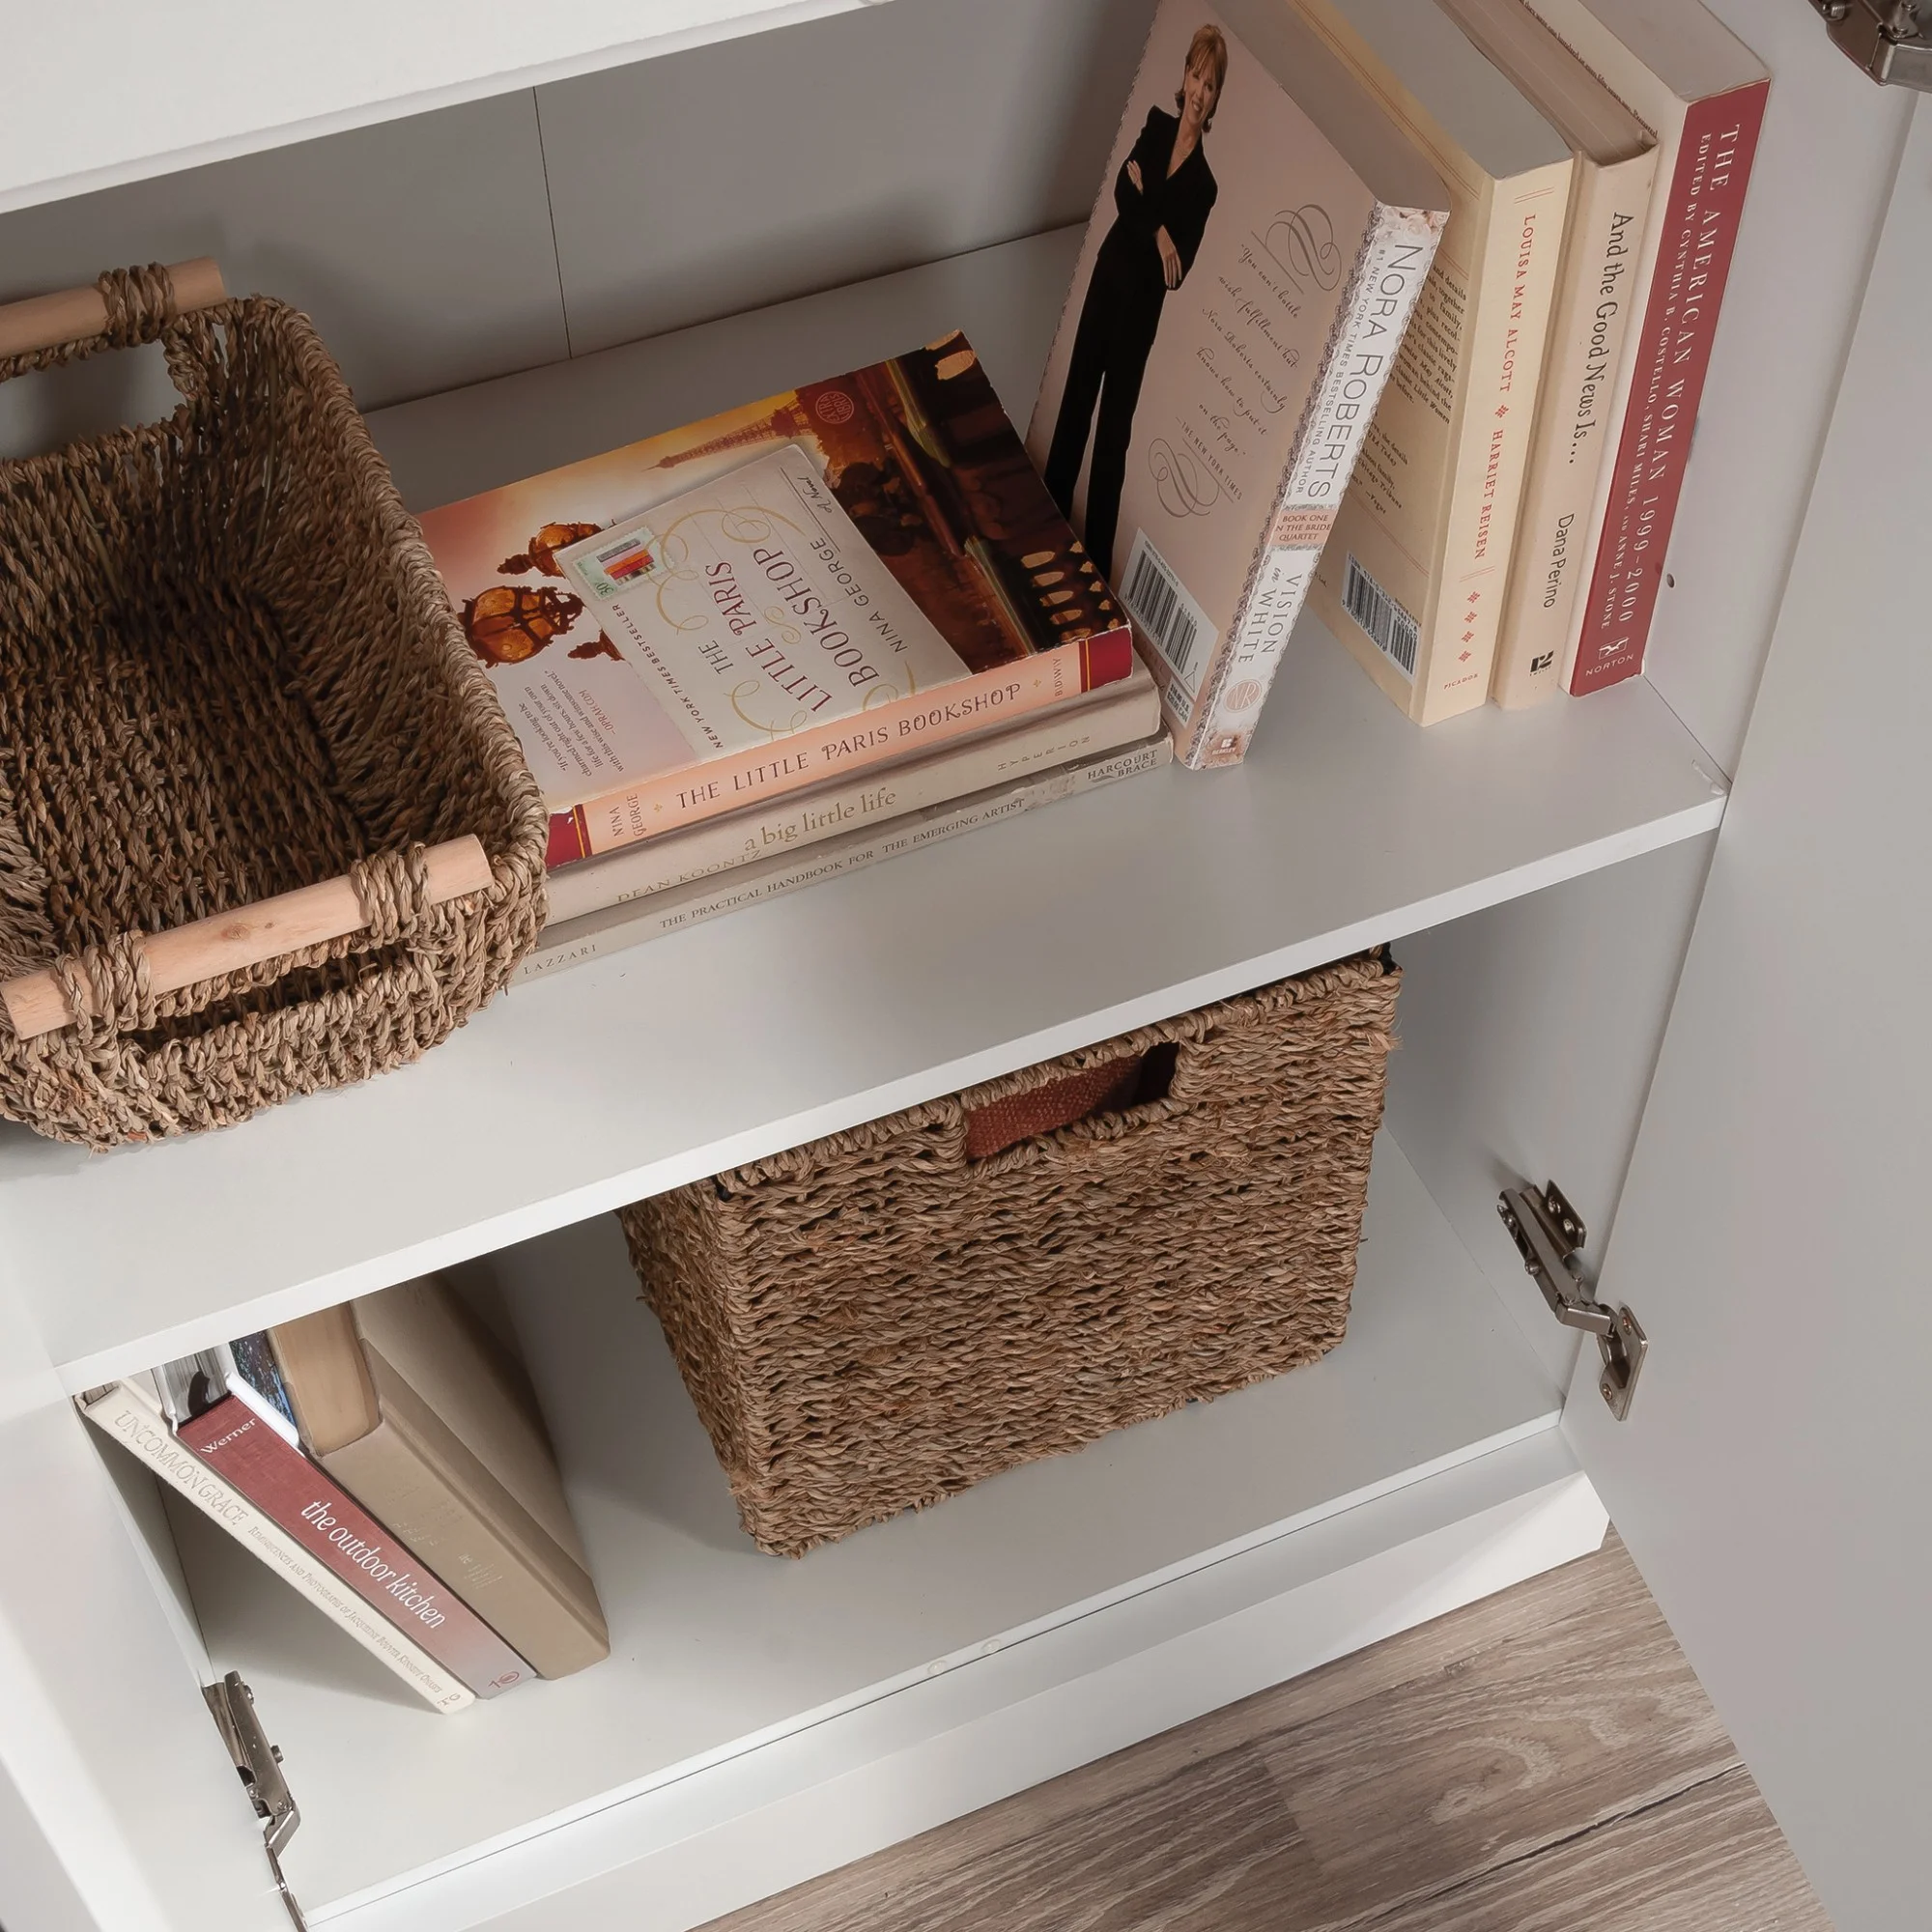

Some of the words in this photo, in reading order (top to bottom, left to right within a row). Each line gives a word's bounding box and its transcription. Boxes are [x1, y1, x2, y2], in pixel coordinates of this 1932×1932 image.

[1690, 132, 1711, 195] EDITED
[1710, 124, 1740, 190] THE
[1685, 202, 1697, 221] BY
[1517, 213, 1536, 279] LOUISA
[1606, 212, 1634, 258] And
[1366, 267, 1379, 294] NEW
[1600, 262, 1625, 296] the
[1668, 229, 1690, 300] CYNTHIA
[1277, 290, 1301, 319] bottle
[1362, 244, 1423, 340] NORA
[1438, 286, 1464, 315] together
[1444, 275, 1466, 300] details
[1510, 285, 1526, 321] MAY
[1673, 210, 1720, 364] AMERICAN
[1218, 276, 1242, 298] wish
[1235, 298, 1283, 352] fulfillment
[1281, 348, 1300, 368] but
[1353, 297, 1369, 328] YORK
[1439, 302, 1463, 330] family,
[1588, 301, 1618, 359] Good
[1202, 308, 1222, 332] Nora
[1224, 331, 1253, 369] Roberts
[1254, 370, 1288, 413] certainly
[1340, 330, 1359, 367] TIMES
[1438, 348, 1457, 374] lively
[1499, 328, 1518, 392] ALCOTT
[1644, 327, 1671, 410] COSTELLO,
[1196, 347, 1219, 379] knows
[1220, 377, 1236, 397] how
[1236, 397, 1244, 409] to
[1258, 426, 1267, 436] it
[1419, 375, 1440, 402] behind
[1577, 364, 1605, 417] News
[1198, 403, 1208, 415] on
[1209, 415, 1230, 431] the
[1307, 353, 1383, 498] ROBERTS
[1313, 372, 1344, 444] BESTSELLING
[1430, 401, 1450, 425] Women
[1636, 413, 1652, 457] SHARI
[1648, 378, 1685, 481] WOMAN
[1193, 437, 1208, 455] NEW
[1208, 454, 1224, 476] YORK
[1224, 475, 1243, 500] TIMES
[1295, 450, 1316, 495] AUTHOR
[1484, 429, 1503, 498] HARRIET
[797, 476, 823, 499] Novel
[1279, 532, 1319, 541] QUARTET
[1283, 514, 1307, 523] BOOK
[1309, 514, 1328, 523] ONE
[1474, 504, 1492, 560] REISEN
[1552, 514, 1575, 557] Dana
[1612, 535, 1628, 568] ANNE
[1618, 496, 1659, 622] 1999-2000
[810, 537, 869, 607] GEORGE
[1271, 566, 1282, 582] in
[1543, 559, 1566, 609] Perino
[705, 561, 757, 637] PARIS
[1262, 573, 1303, 654] VISION
[1600, 587, 1617, 630] STONE
[611, 604, 660, 666] BESTSELLER
[753, 548, 880, 688] BOOKSHOP
[869, 611, 908, 653] NINA
[1238, 589, 1277, 664] WHITE
[698, 639, 734, 675] THE
[745, 638, 833, 712] LITTLE
[1585, 654, 1634, 676] NORTON
[524, 686, 537, 699] own
[540, 683, 555, 701] down
[657, 665, 684, 696] TIMES
[1443, 673, 1479, 690] PICADOR
[518, 702, 527, 712] be
[524, 710, 532, 719] to
[533, 699, 550, 714] your
[552, 700, 562, 709] sit
[561, 689, 584, 717] winsome
[679, 696, 707, 725] YORK
[528, 717, 550, 742] looking
[549, 721, 560, 732] out
[556, 731, 572, 748] right
[572, 728, 584, 741] few
[579, 716, 594, 728] and
[590, 727, 603, 743] wise
[701, 724, 724, 750] NEW
[566, 747, 591, 776] charmed
[583, 745, 595, 755] for
[590, 754, 603, 767] life
[600, 742, 613, 755] this
[609, 754, 624, 772] with
[676, 781, 721, 810] THE
[733, 752, 810, 791] LITTLE
[821, 726, 889, 760] PARIS
[898, 683, 1021, 737] BOOKSHOP
[997, 735, 1091, 771] HYPERION
[1087, 749, 1158, 781] HARCOURT
[1118, 757, 1157, 779] BRACE
[610, 807, 624, 837] NINA
[626, 793, 647, 837] GEORGE
[744, 837, 756, 852] a
[760, 822, 799, 847] big
[802, 802, 855, 832] little
[861, 786, 896, 813] life
[617, 879, 671, 902] DEAN
[679, 850, 762, 882] KOONTZ
[659, 914, 687, 929] THE
[692, 888, 762, 919] PRACTICAL
[767, 860, 843, 893] HANDBOOK
[848, 850, 874, 866] FOR
[882, 838, 908, 853] THE
[913, 814, 979, 843] EMERGING
[981, 798, 1025, 820] ARTIST
[524, 944, 597, 975] LAZZARI
[200, 1418, 256, 1454] Werner
[114, 1410, 208, 1489] UNCOMMON
[198, 1484, 248, 1526] GRACE
[300, 1500, 337, 1531] the
[328, 1527, 396, 1582] outdoor
[385, 1574, 446, 1629] kitchen
